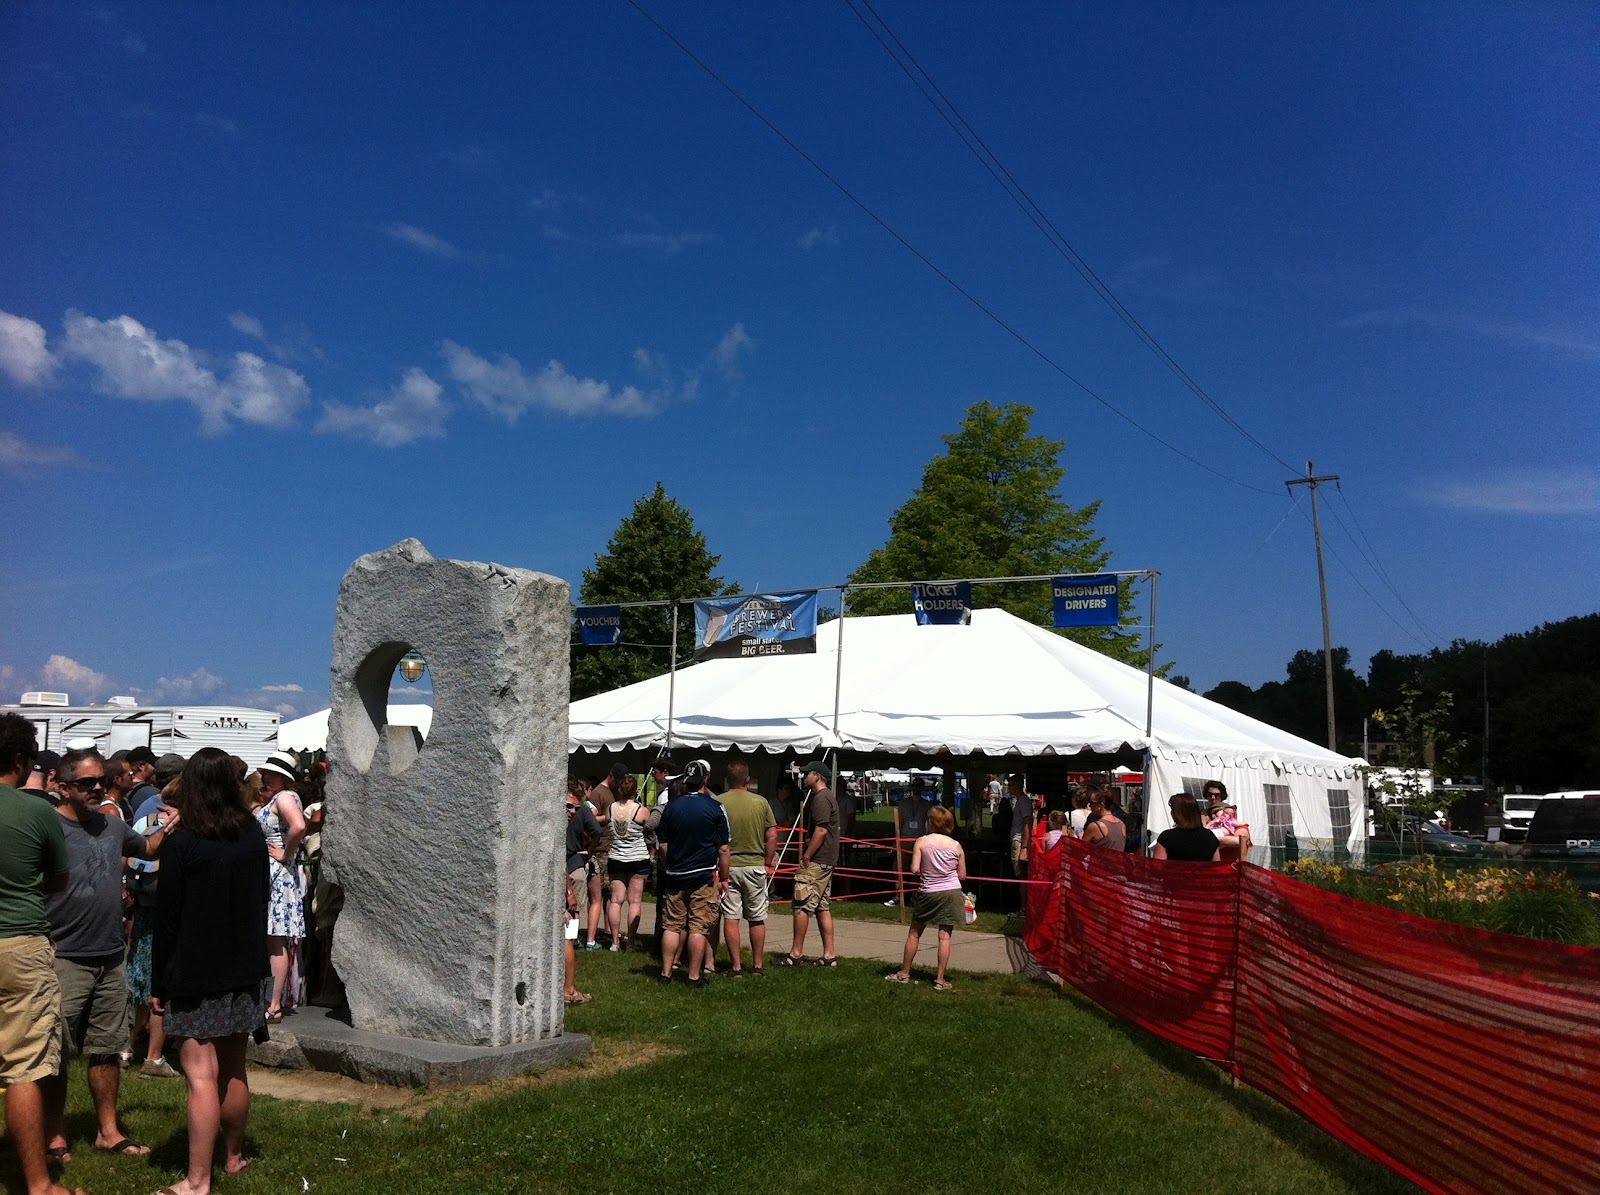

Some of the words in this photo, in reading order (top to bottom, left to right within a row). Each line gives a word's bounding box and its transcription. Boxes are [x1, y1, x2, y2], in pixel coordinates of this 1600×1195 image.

[913, 584, 957, 597] TICKET
[1054, 585, 1117, 597] DESIGNATED
[914, 600, 964, 611] HOLDERS
[1065, 599, 1107, 610] DRIVERS
[734, 609, 793, 623] BREWERS
[730, 619, 796, 636] FESTIVAL
[742, 637, 760, 646] small
[741, 646, 756, 656] BIG
[759, 644, 785, 655] BEER.
[203, 720, 249, 730] SALEM
